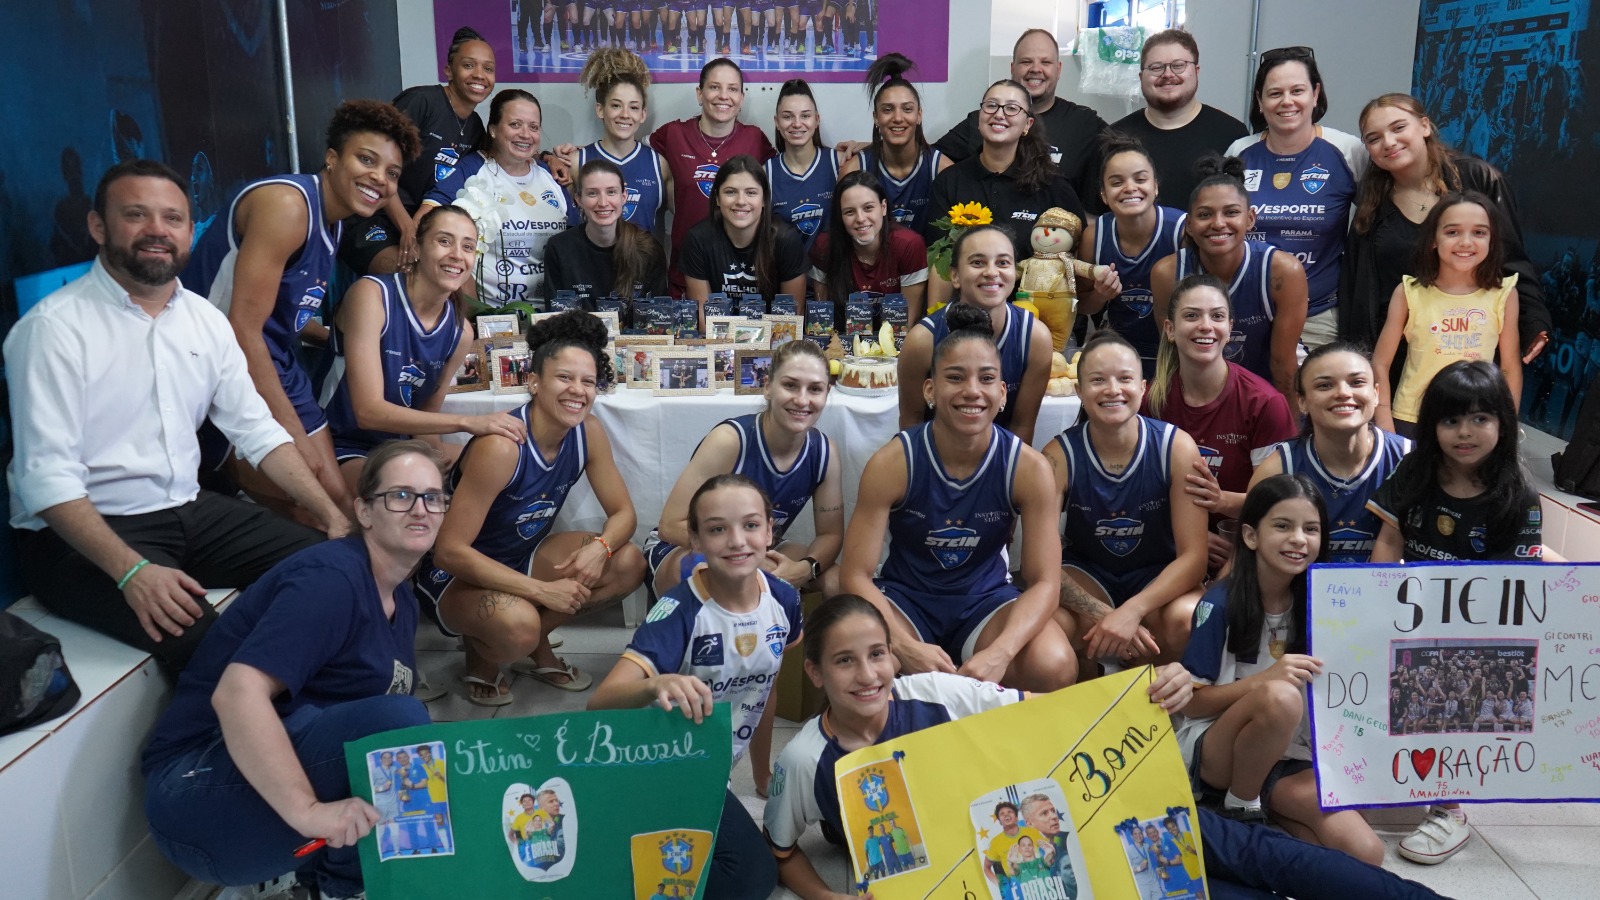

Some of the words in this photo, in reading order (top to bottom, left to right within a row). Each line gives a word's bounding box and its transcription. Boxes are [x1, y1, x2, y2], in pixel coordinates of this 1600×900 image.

[693, 170, 718, 179] STE
[1244, 233, 1267, 242] AVAN
[519, 262, 545, 276] CRE
[721, 284, 758, 294] MELHO
[1441, 317, 1469, 332] SUN
[1440, 333, 1483, 350] SHINE
[515, 506, 558, 525] STEIN
[1094, 522, 1145, 536] STEIN
[924, 536, 981, 548] STEIN
[1328, 540, 1377, 551] TEIN
[1371, 570, 1408, 580] LARISSA
[1326, 582, 1363, 597] FLÁVIA
[1378, 580, 1390, 588] 22
[1563, 577, 1581, 592] 33
[1393, 575, 1547, 633] STEIN
[1327, 671, 1370, 709] DO
[1342, 708, 1365, 722] DANI
[1366, 717, 1388, 732] GELO
[1541, 708, 1573, 724] BIANCA
[454, 739, 533, 775] Stein
[554, 719, 577, 765] É
[1069, 724, 1158, 802] Bom
[1344, 757, 1368, 776] Bebel
[1351, 773, 1366, 785] 98
[1435, 781, 1448, 790] 75
[1409, 788, 1471, 799] AMANDINHA
